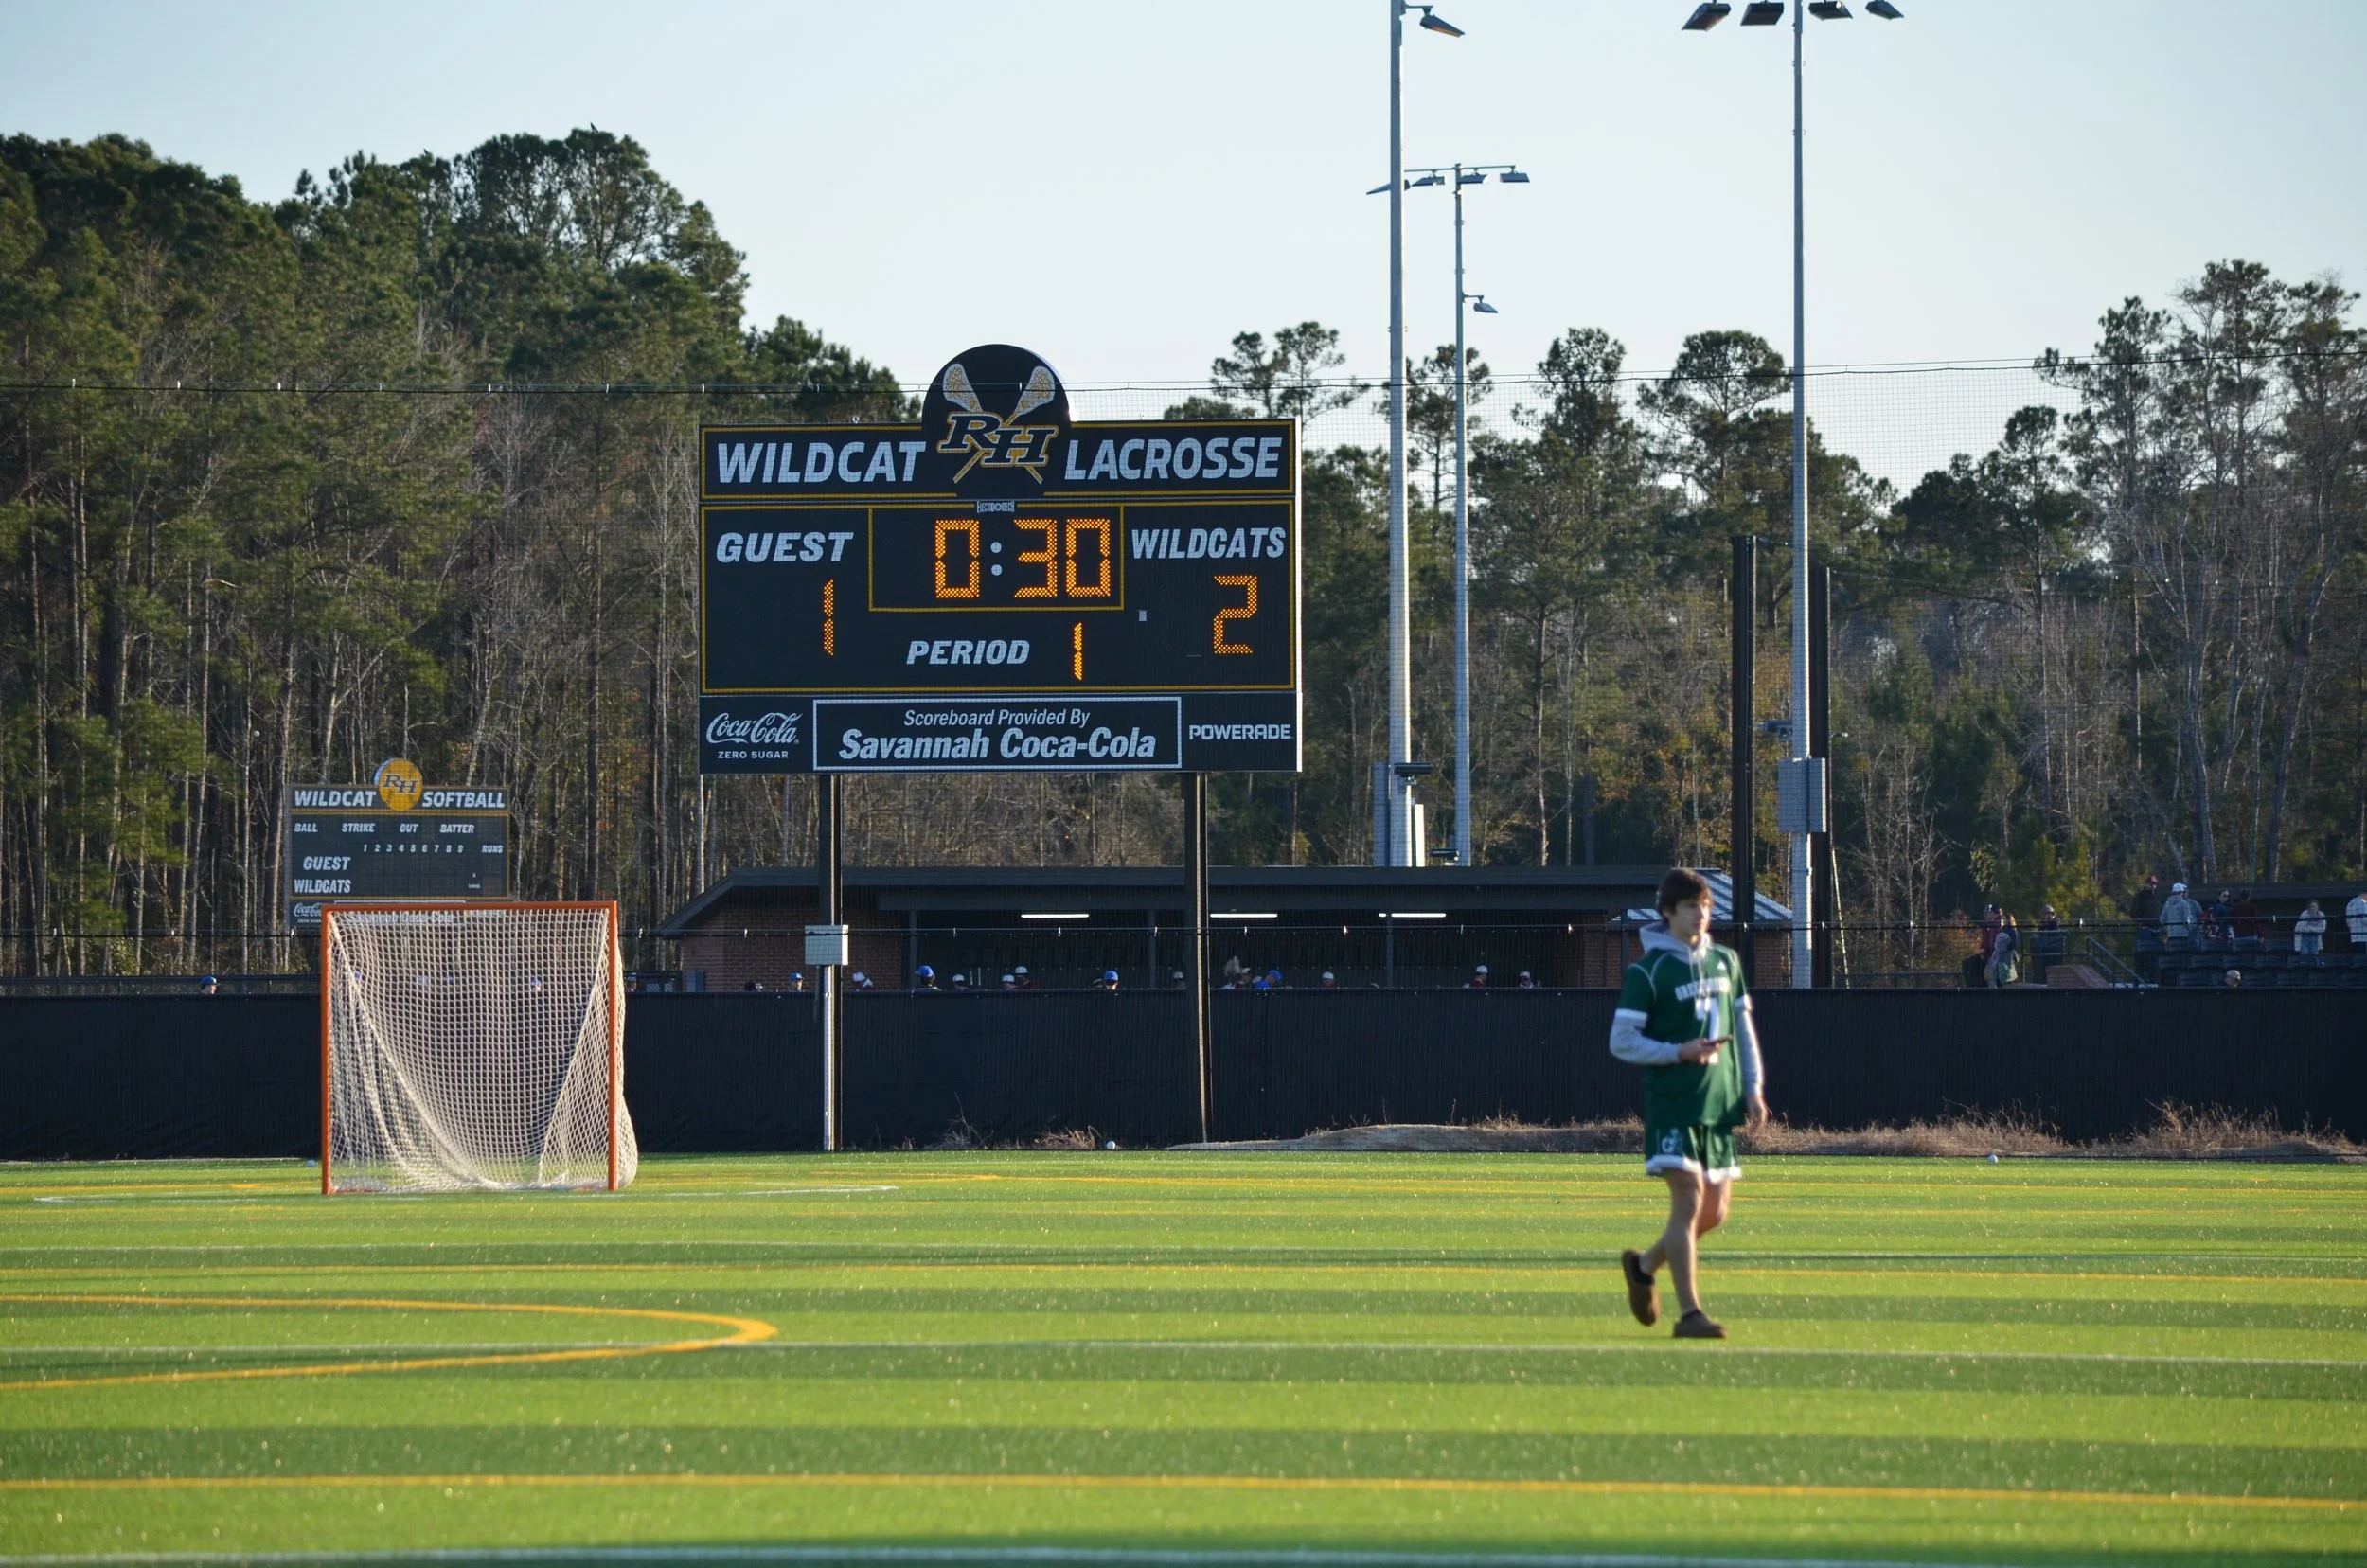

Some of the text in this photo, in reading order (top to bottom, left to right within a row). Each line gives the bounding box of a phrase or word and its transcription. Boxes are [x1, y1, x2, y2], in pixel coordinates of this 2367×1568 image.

[718, 437, 1282, 483] WILDCAT LACROSSE
[716, 531, 854, 563] GUEST
[1131, 526, 1287, 559] WILDCATS
[935, 519, 1111, 598] 0:30
[824, 579, 834, 656] 1
[1213, 575, 1257, 654] 2
[906, 640, 1030, 665] PERIOD
[1074, 622, 1083, 681] 1
[705, 712, 803, 744] Coca-Cola
[904, 708, 1090, 728] Scoreboard Provided By
[1189, 724, 1291, 739] POWERADE
[718, 750, 789, 759] ZERO SUGAR
[838, 726, 1157, 759] Savannah Coca-Cola
[294, 790, 505, 808] WILDCAT SOFTBALL
[294, 823, 474, 833] BALL STRIKE OUT BATTER
[364, 844, 368, 852] 1
[374, 844, 381, 852] 2
[386, 844, 393, 852] 3
[399, 844, 404, 852] 4
[446, 845, 452, 853] 8
[457, 845, 464, 853] 9
[482, 845, 504, 853] RUNS
[303, 856, 351, 870] GUEST
[294, 879, 351, 893] WILDCATS
